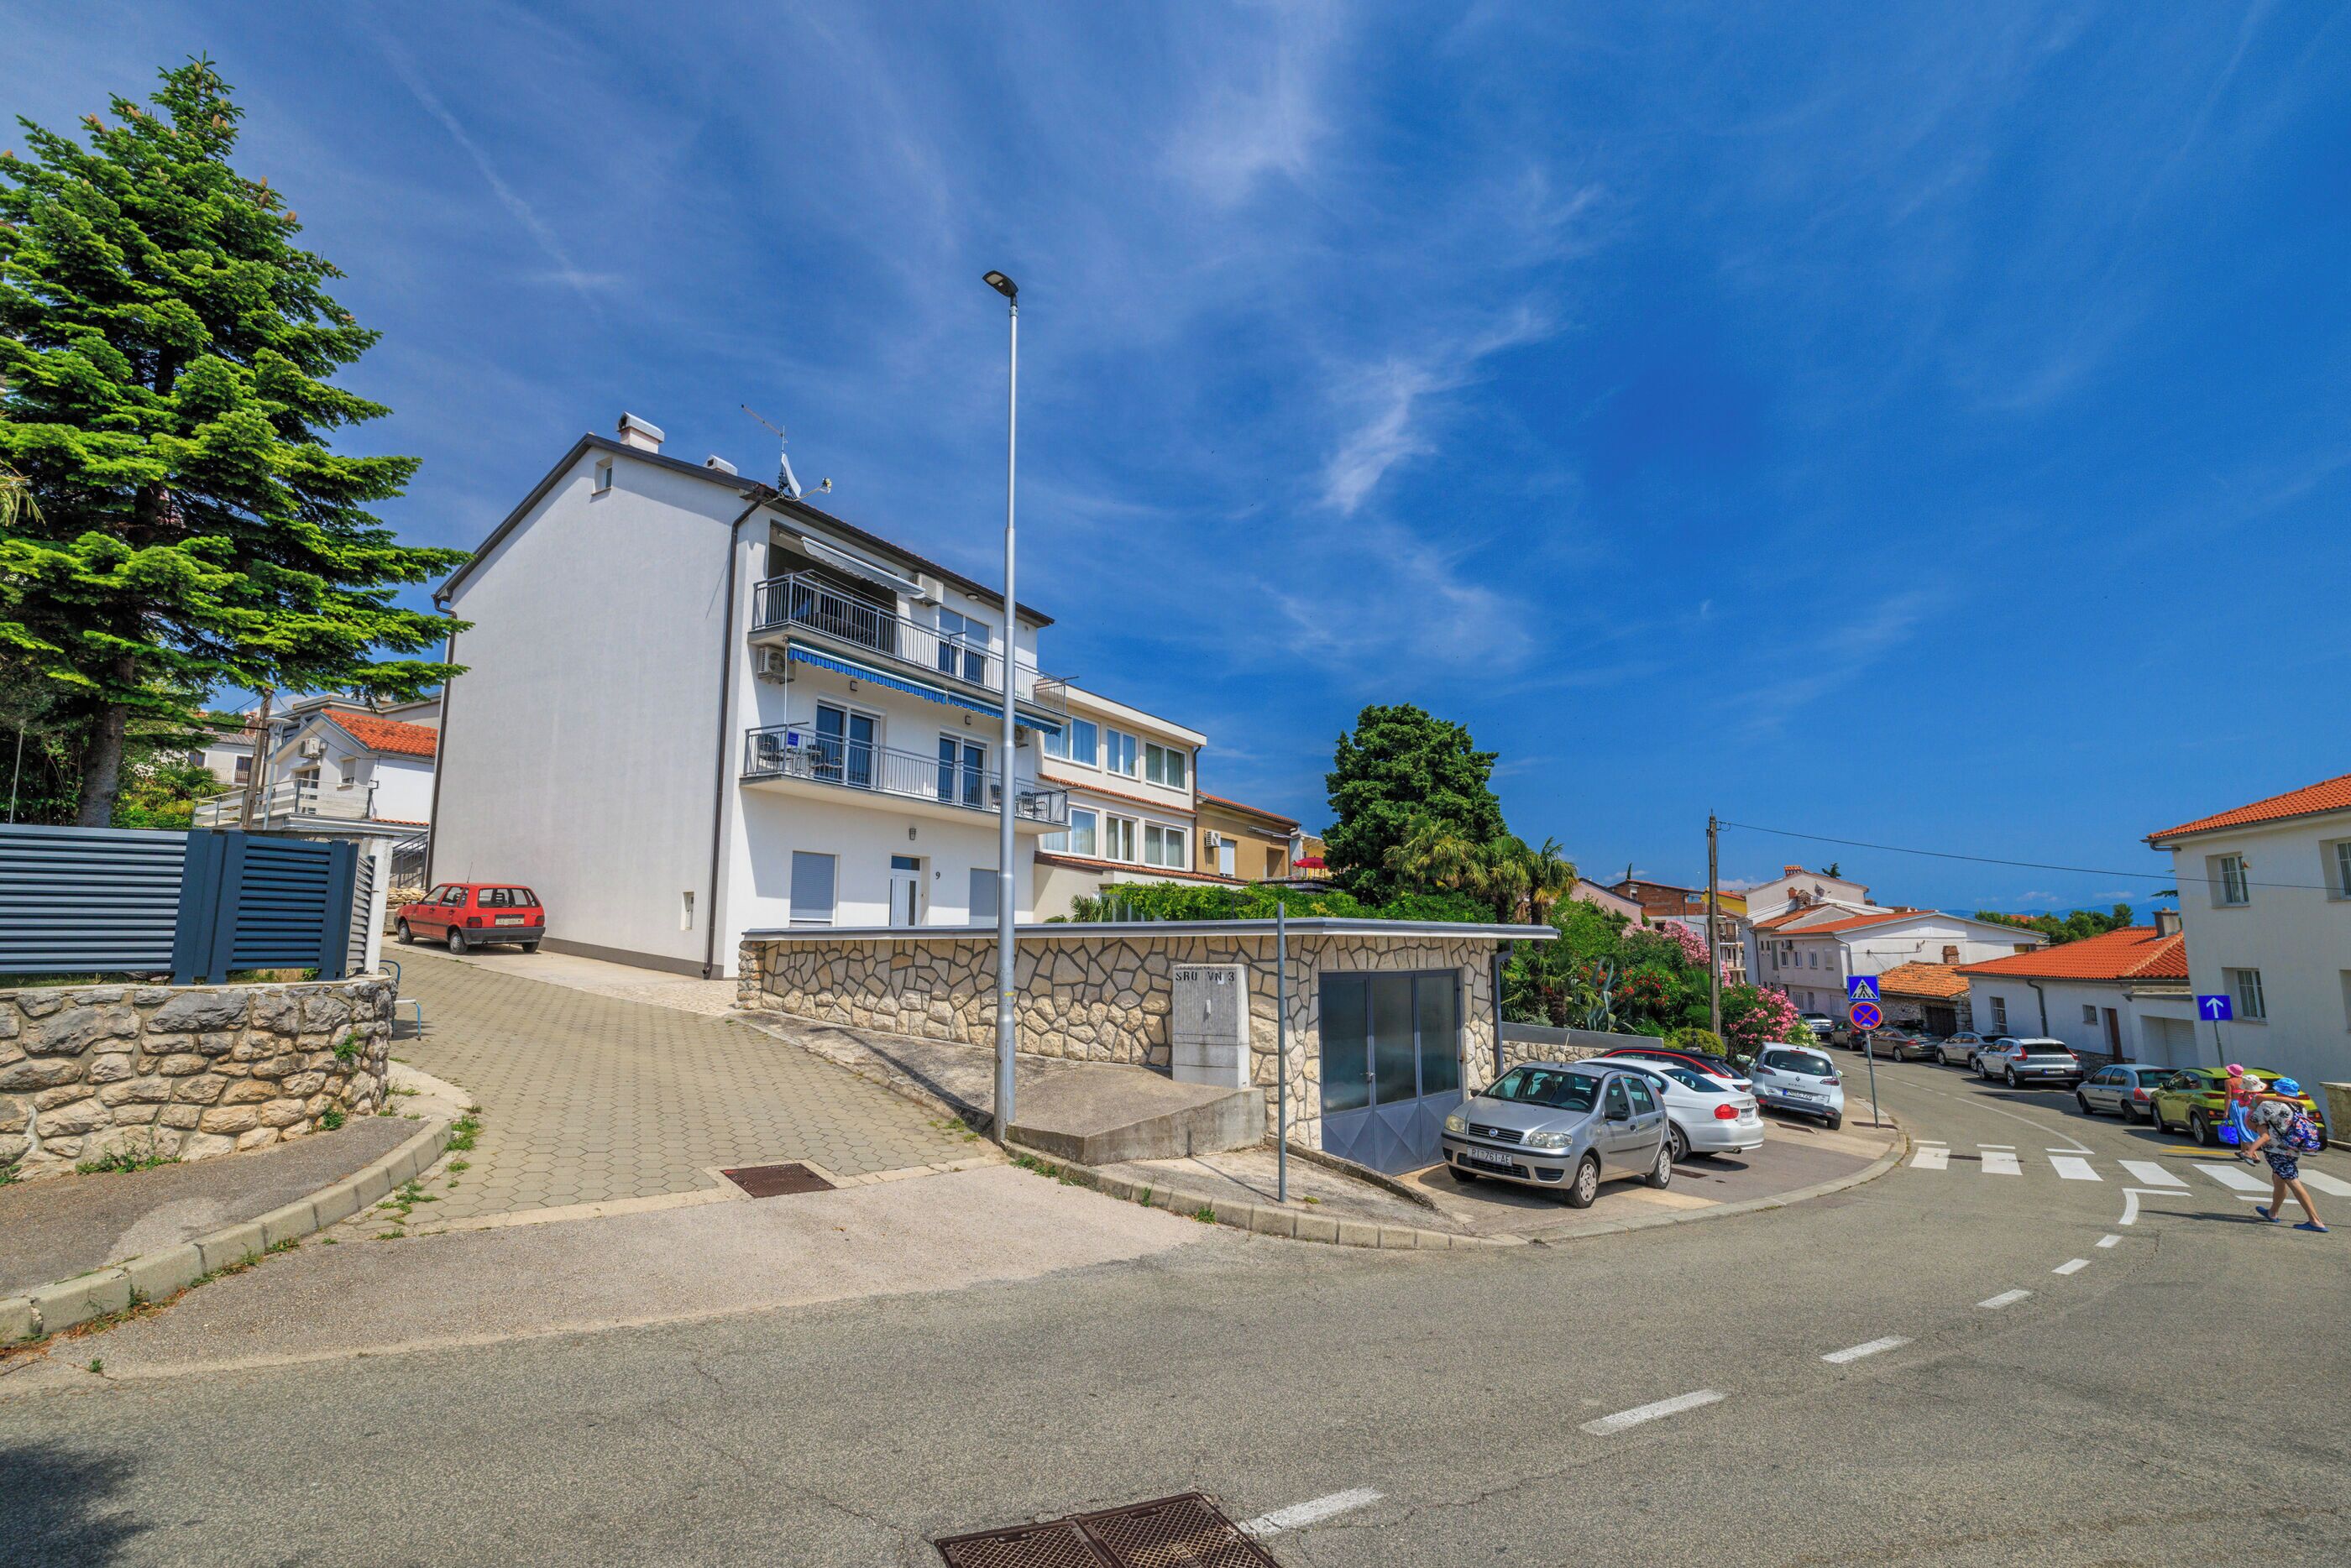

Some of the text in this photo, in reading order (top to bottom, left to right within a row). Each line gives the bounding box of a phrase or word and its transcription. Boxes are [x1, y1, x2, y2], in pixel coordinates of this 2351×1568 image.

[935, 871, 940, 880] 9
[1207, 971, 1222, 981] VN
[1228, 971, 1235, 981] 3
[1471, 1148, 1479, 1158] RI
